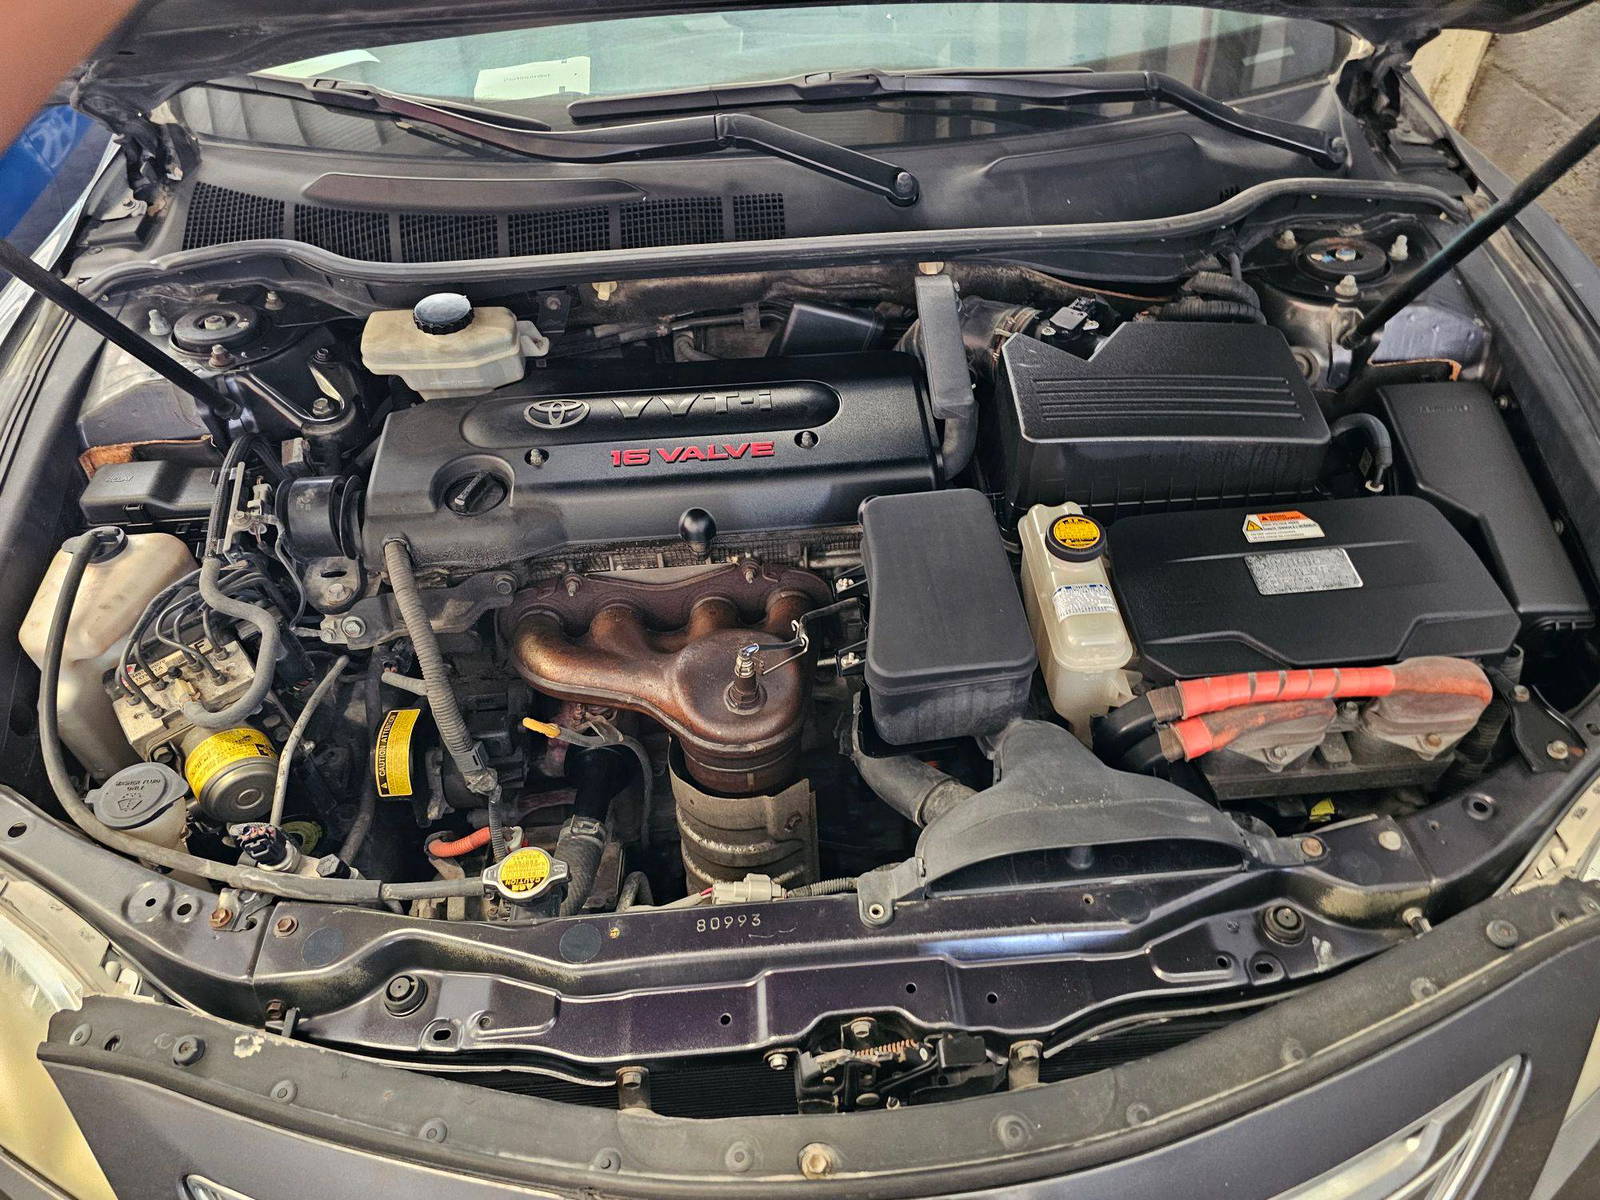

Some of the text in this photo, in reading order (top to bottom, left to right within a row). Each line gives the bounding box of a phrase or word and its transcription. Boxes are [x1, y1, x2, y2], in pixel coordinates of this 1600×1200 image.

[610, 390, 772, 419] VVT-i
[610, 441, 776, 467] 16 VALVE
[505, 876, 541, 886] CAUTION
[696, 913, 761, 933] 80993
